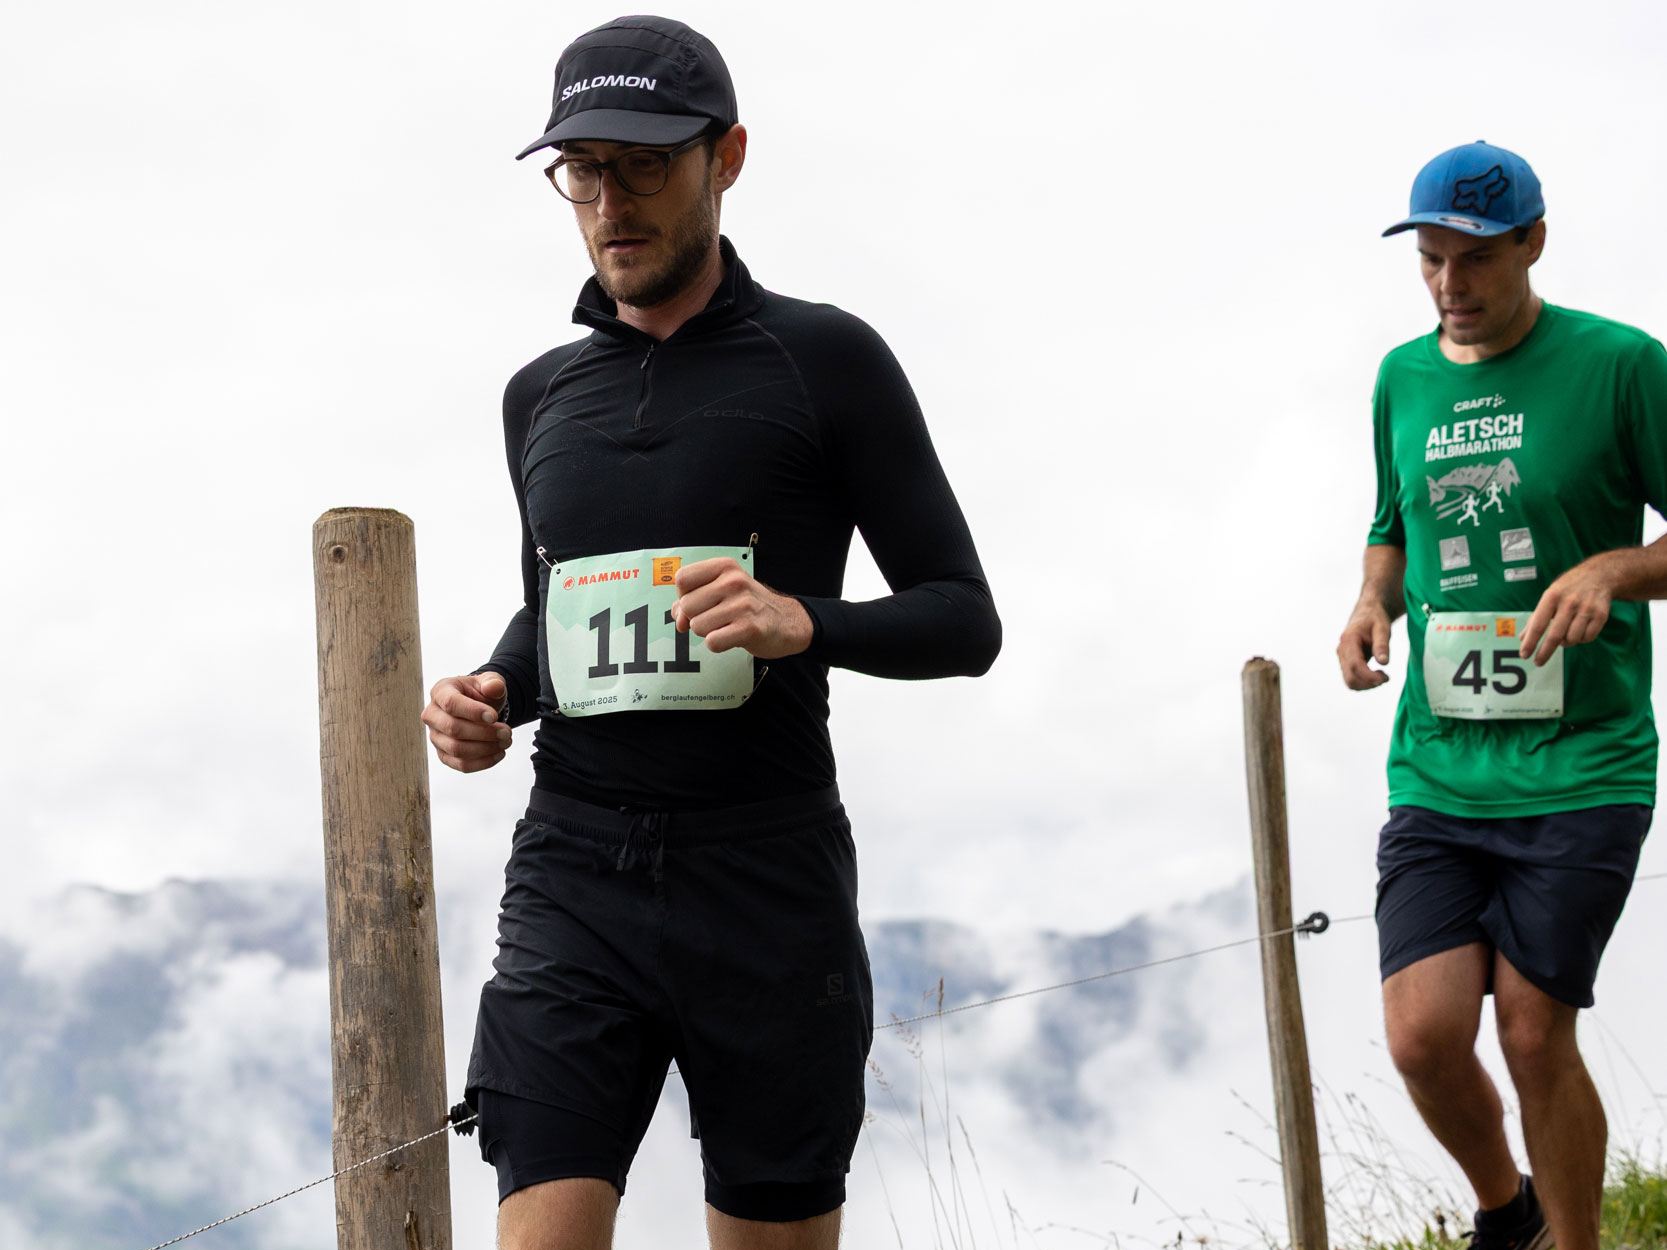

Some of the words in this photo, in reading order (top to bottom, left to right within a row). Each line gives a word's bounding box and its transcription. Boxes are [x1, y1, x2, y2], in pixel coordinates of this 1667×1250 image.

[561, 75, 657, 101] SALOMON
[1453, 396, 1493, 412] CRAFT
[1425, 413, 1524, 448] ALETSCH
[1425, 435, 1522, 462] HALBMARATHON
[578, 568, 640, 586] MAMMUT
[588, 604, 701, 679] 111
[1452, 650, 1527, 695] 45
[563, 702, 569, 710] 3.
[570, 698, 595, 710] August
[597, 695, 618, 705] 2025
[661, 694, 735, 702] berglaufengelberg.ch
